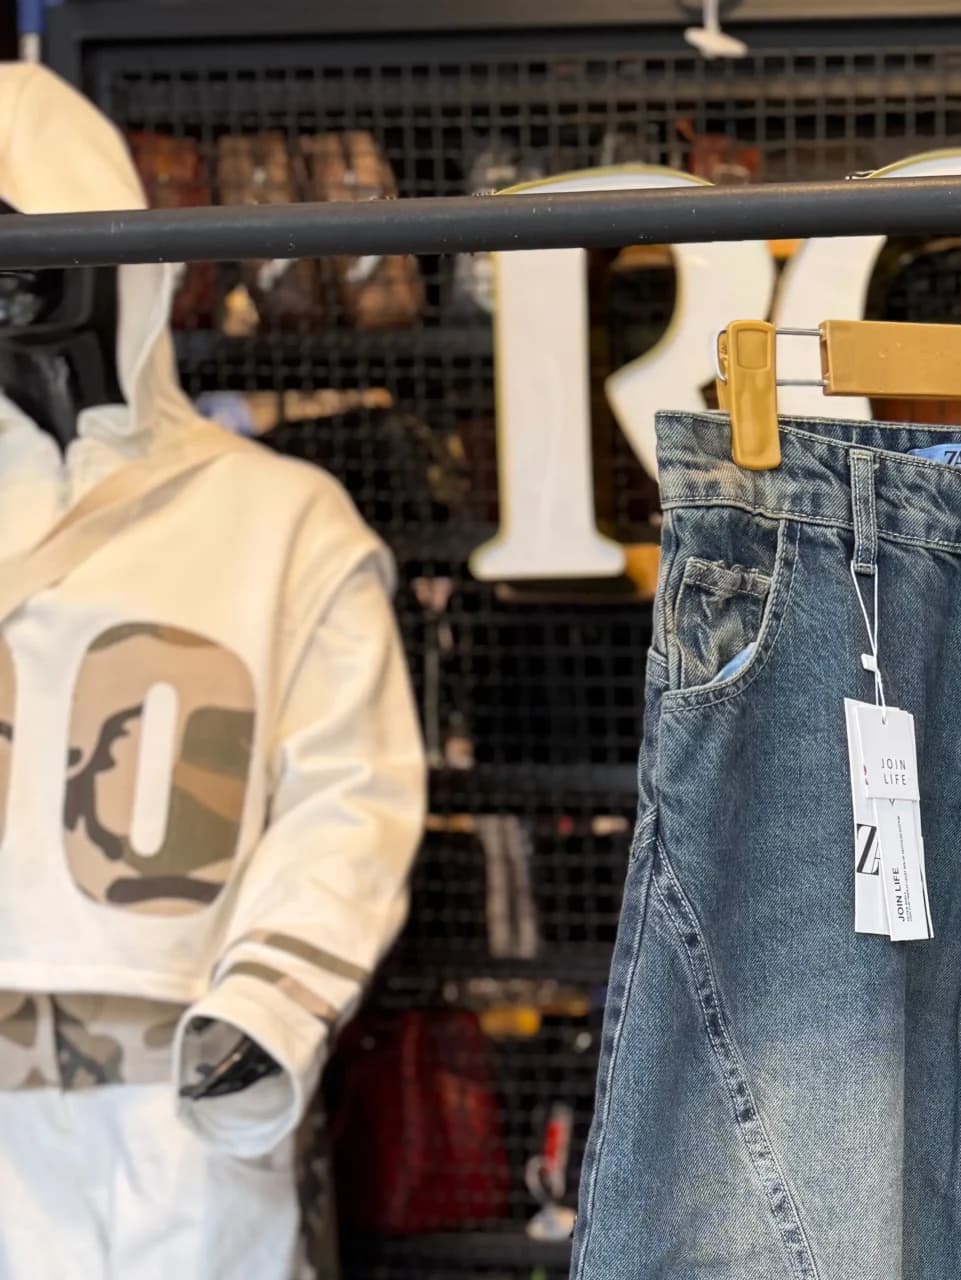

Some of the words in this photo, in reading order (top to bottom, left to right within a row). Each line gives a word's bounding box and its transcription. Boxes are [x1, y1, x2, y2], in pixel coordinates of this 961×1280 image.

[881, 758, 907, 770] JOIN
[883, 774, 908, 786] LIFE
[892, 867, 901, 892] LIFE
[896, 895, 905, 922] JOIN
